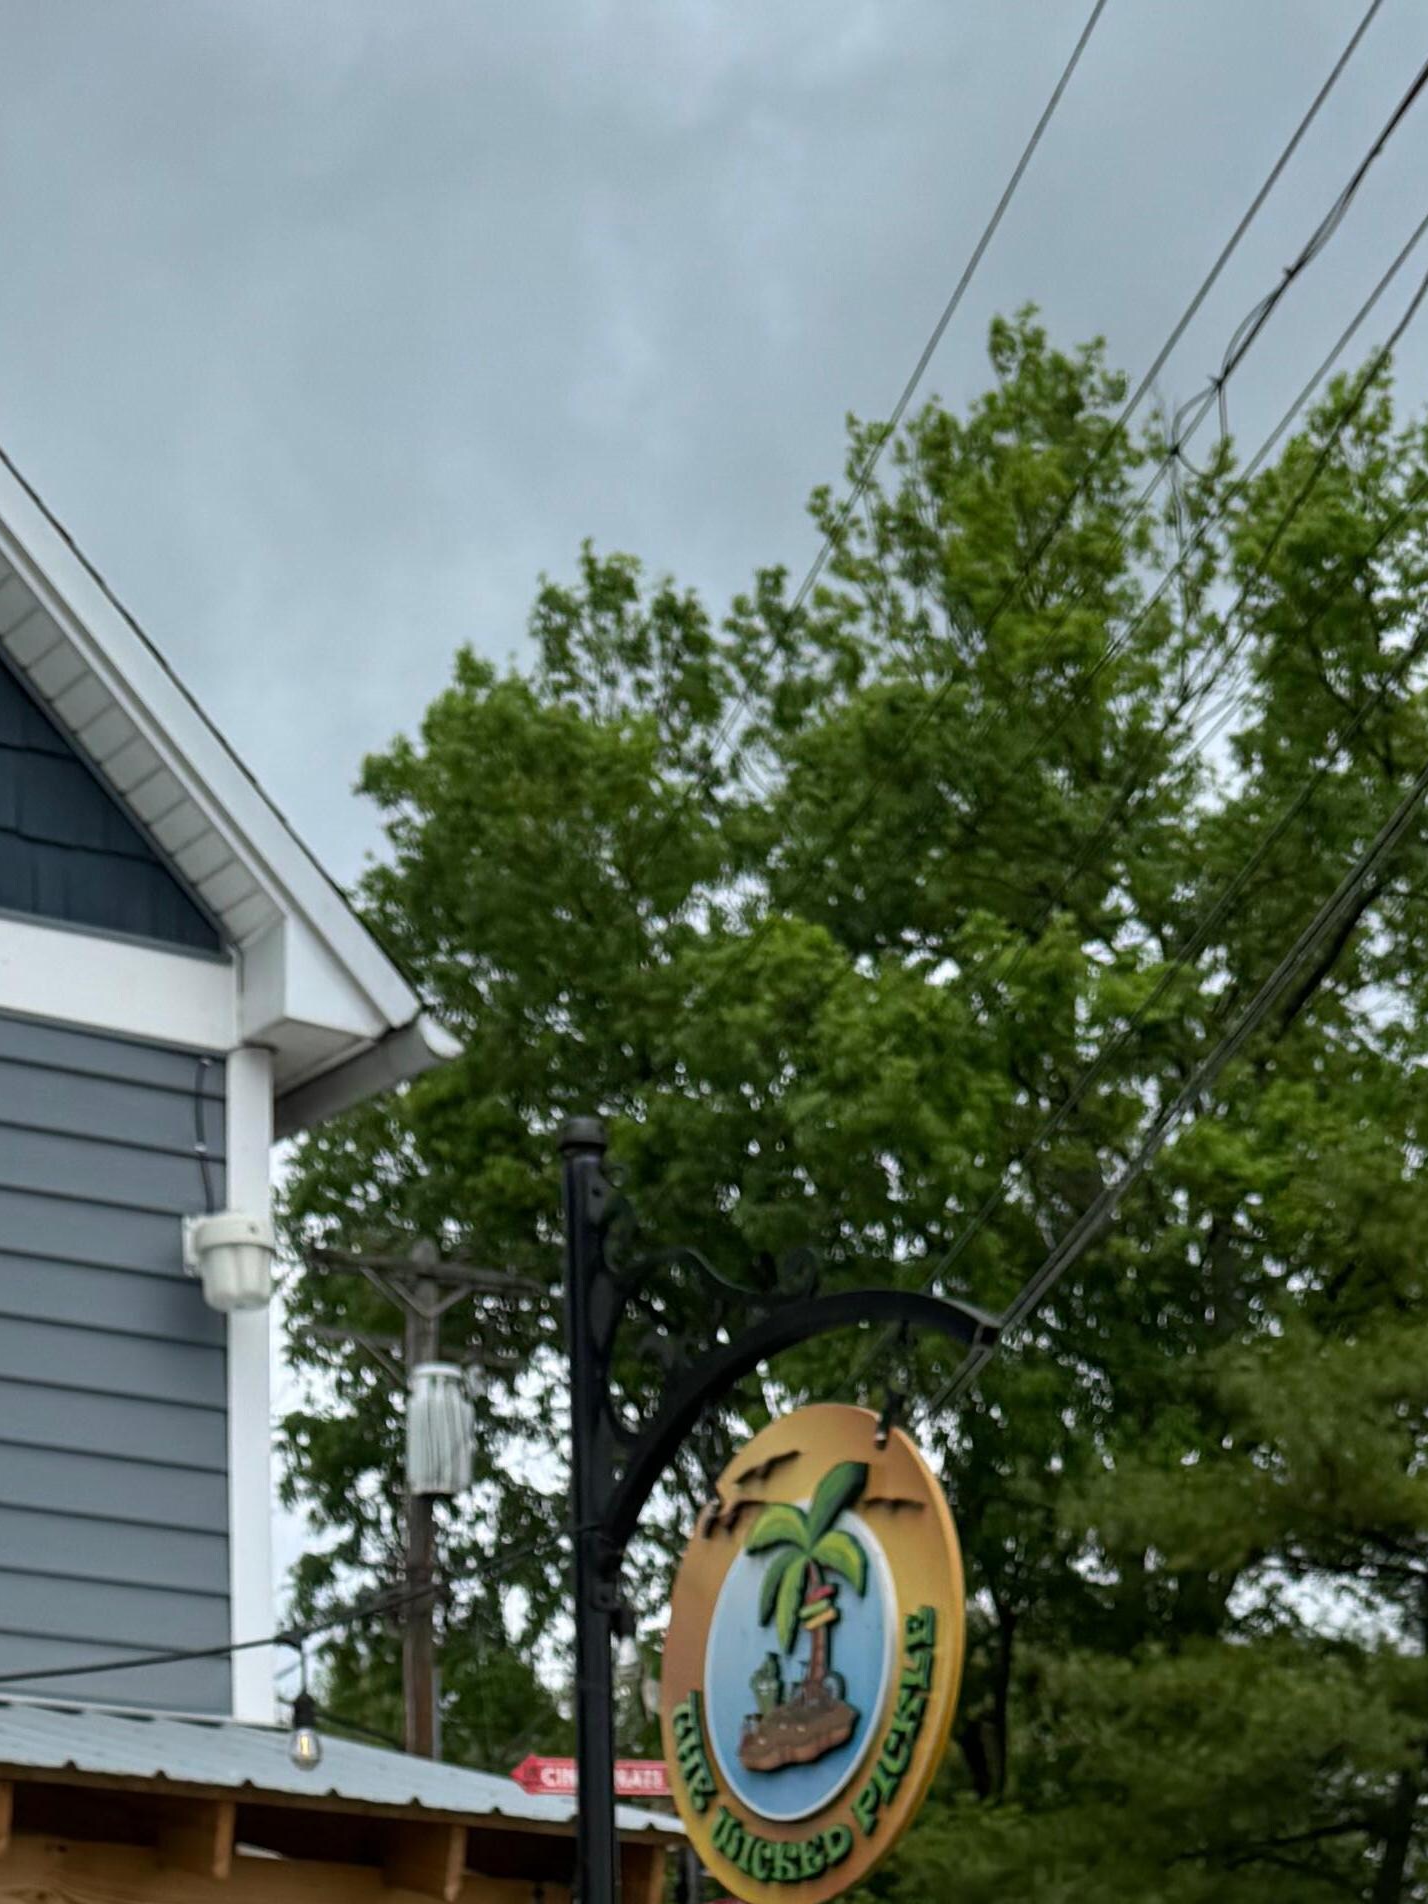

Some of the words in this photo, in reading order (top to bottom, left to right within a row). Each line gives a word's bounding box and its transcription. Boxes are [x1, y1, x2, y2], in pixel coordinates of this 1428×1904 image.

[672, 1690, 718, 1813] THE
[710, 1805, 854, 1883] WICKED
[852, 1604, 937, 1837] PICKLE
